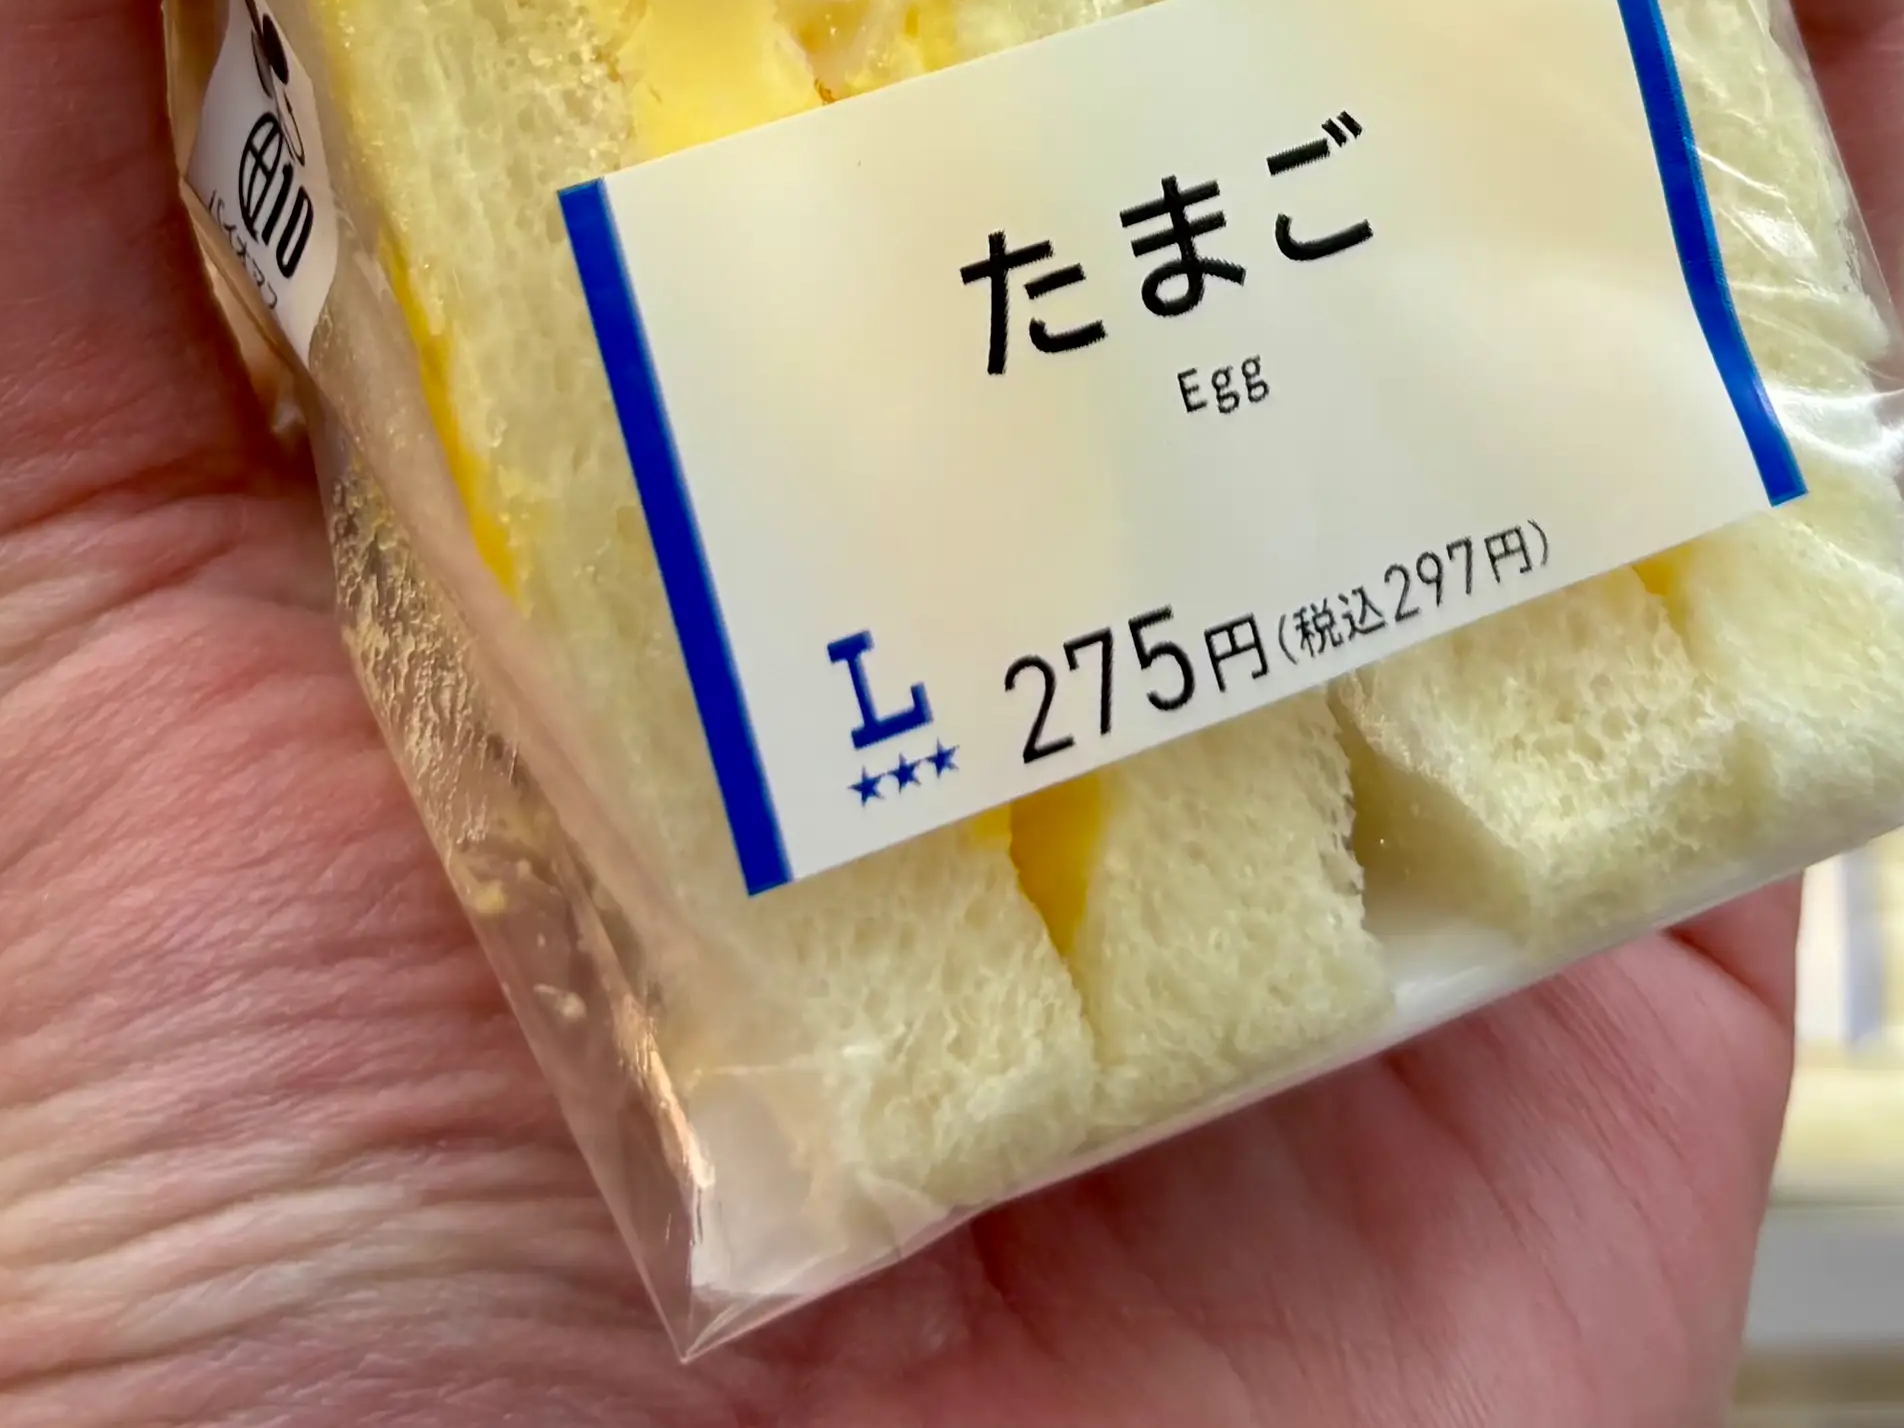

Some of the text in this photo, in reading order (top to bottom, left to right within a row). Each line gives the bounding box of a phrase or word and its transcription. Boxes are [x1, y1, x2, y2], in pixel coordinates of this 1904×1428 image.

[960, 110, 1373, 376] たまご
[1177, 354, 1270, 414] Egg
[826, 629, 933, 750] L
